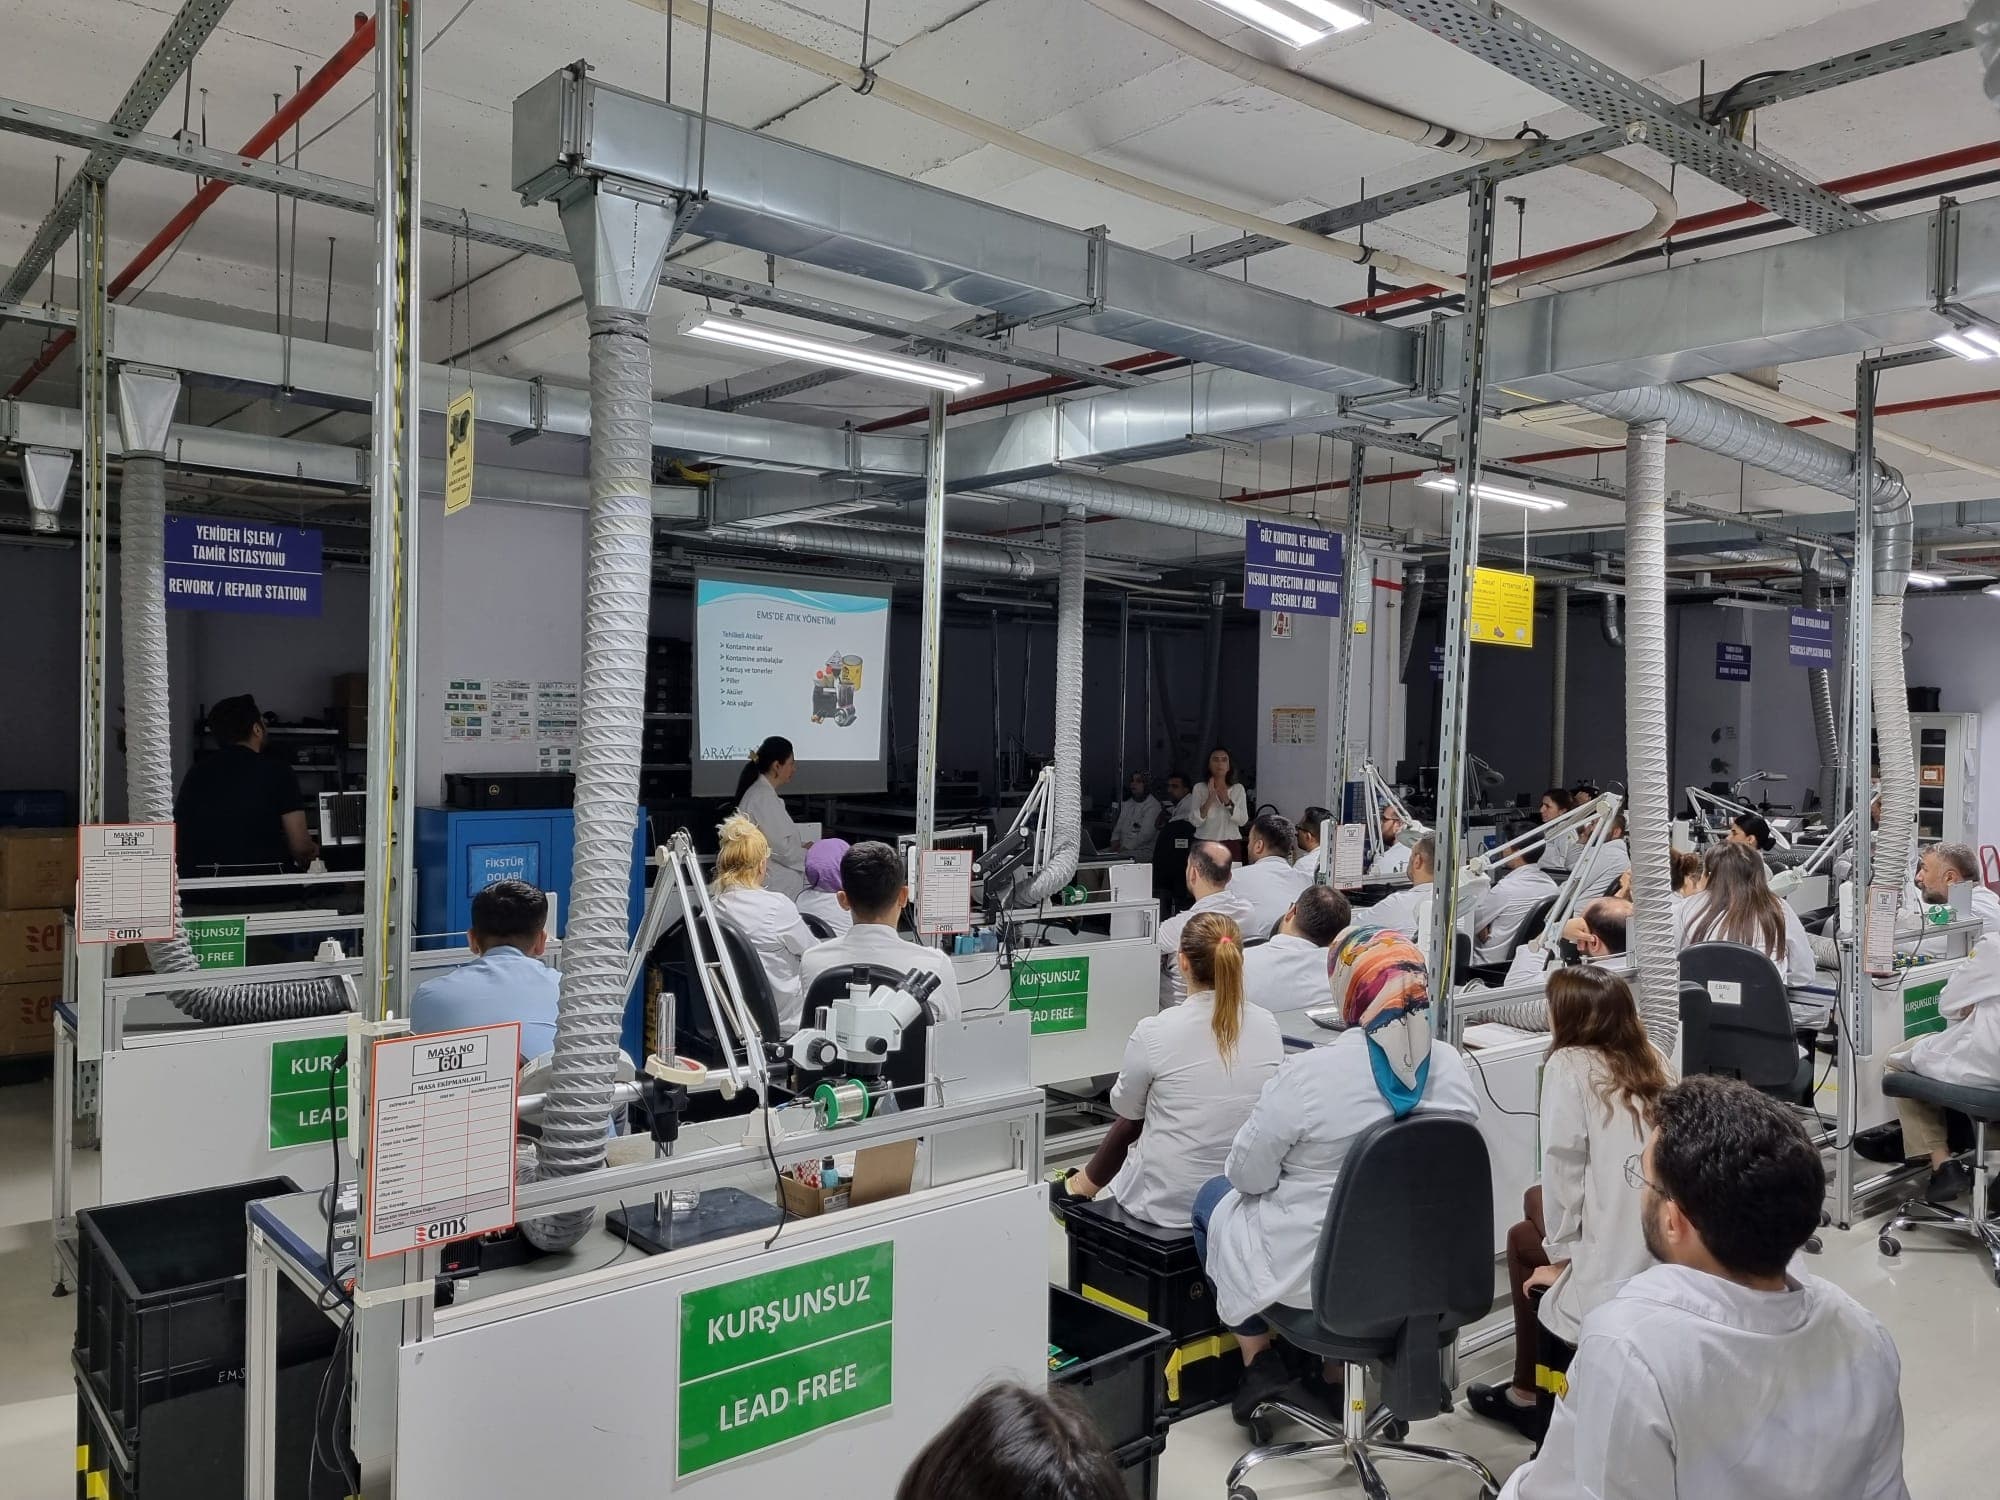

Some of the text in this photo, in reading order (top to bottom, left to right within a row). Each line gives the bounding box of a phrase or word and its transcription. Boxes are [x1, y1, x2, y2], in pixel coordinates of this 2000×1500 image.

[196, 525, 282, 548] YENİDEN İŞLEM /
[1260, 528, 1329, 551] GÖZ KONTROL VE MANUEL
[192, 544, 286, 566] TAMİR İSTASYONU
[1275, 549, 1315, 566] MONTAJ ALANI
[169, 578, 307, 601] REWORK / REPAIR STATION
[1248, 571, 1338, 594] VISUAL INSPECTION AND MANUAL
[1271, 592, 1316, 609] ASSEMBLY AREA
[785, 612, 800, 623] ATIK
[802, 613, 836, 625] YÖNETİMİ
[725, 643, 756, 651] Kontamine
[725, 654, 756, 663] Kontamine
[725, 665, 743, 675] Kartuş
[117, 928, 142, 939] ems
[187, 927, 241, 940] RŞUNSUZ
[207, 951, 235, 962] FREE
[1020, 970, 1080, 987] KURŞUNSUZ
[1905, 996, 1932, 1012] KURŞUNSUZ
[1050, 1007, 1074, 1020] FREE
[427, 1043, 474, 1058] MASA NO
[440, 1054, 461, 1071] 60
[417, 1083, 437, 1092] MASA
[299, 1105, 348, 1127] LEAD
[428, 1216, 466, 1240] ems
[708, 1275, 871, 1345] KURŞUNSUZ
[218, 1367, 245, 1383] EMS
[720, 1363, 857, 1432] LEAD FREE
